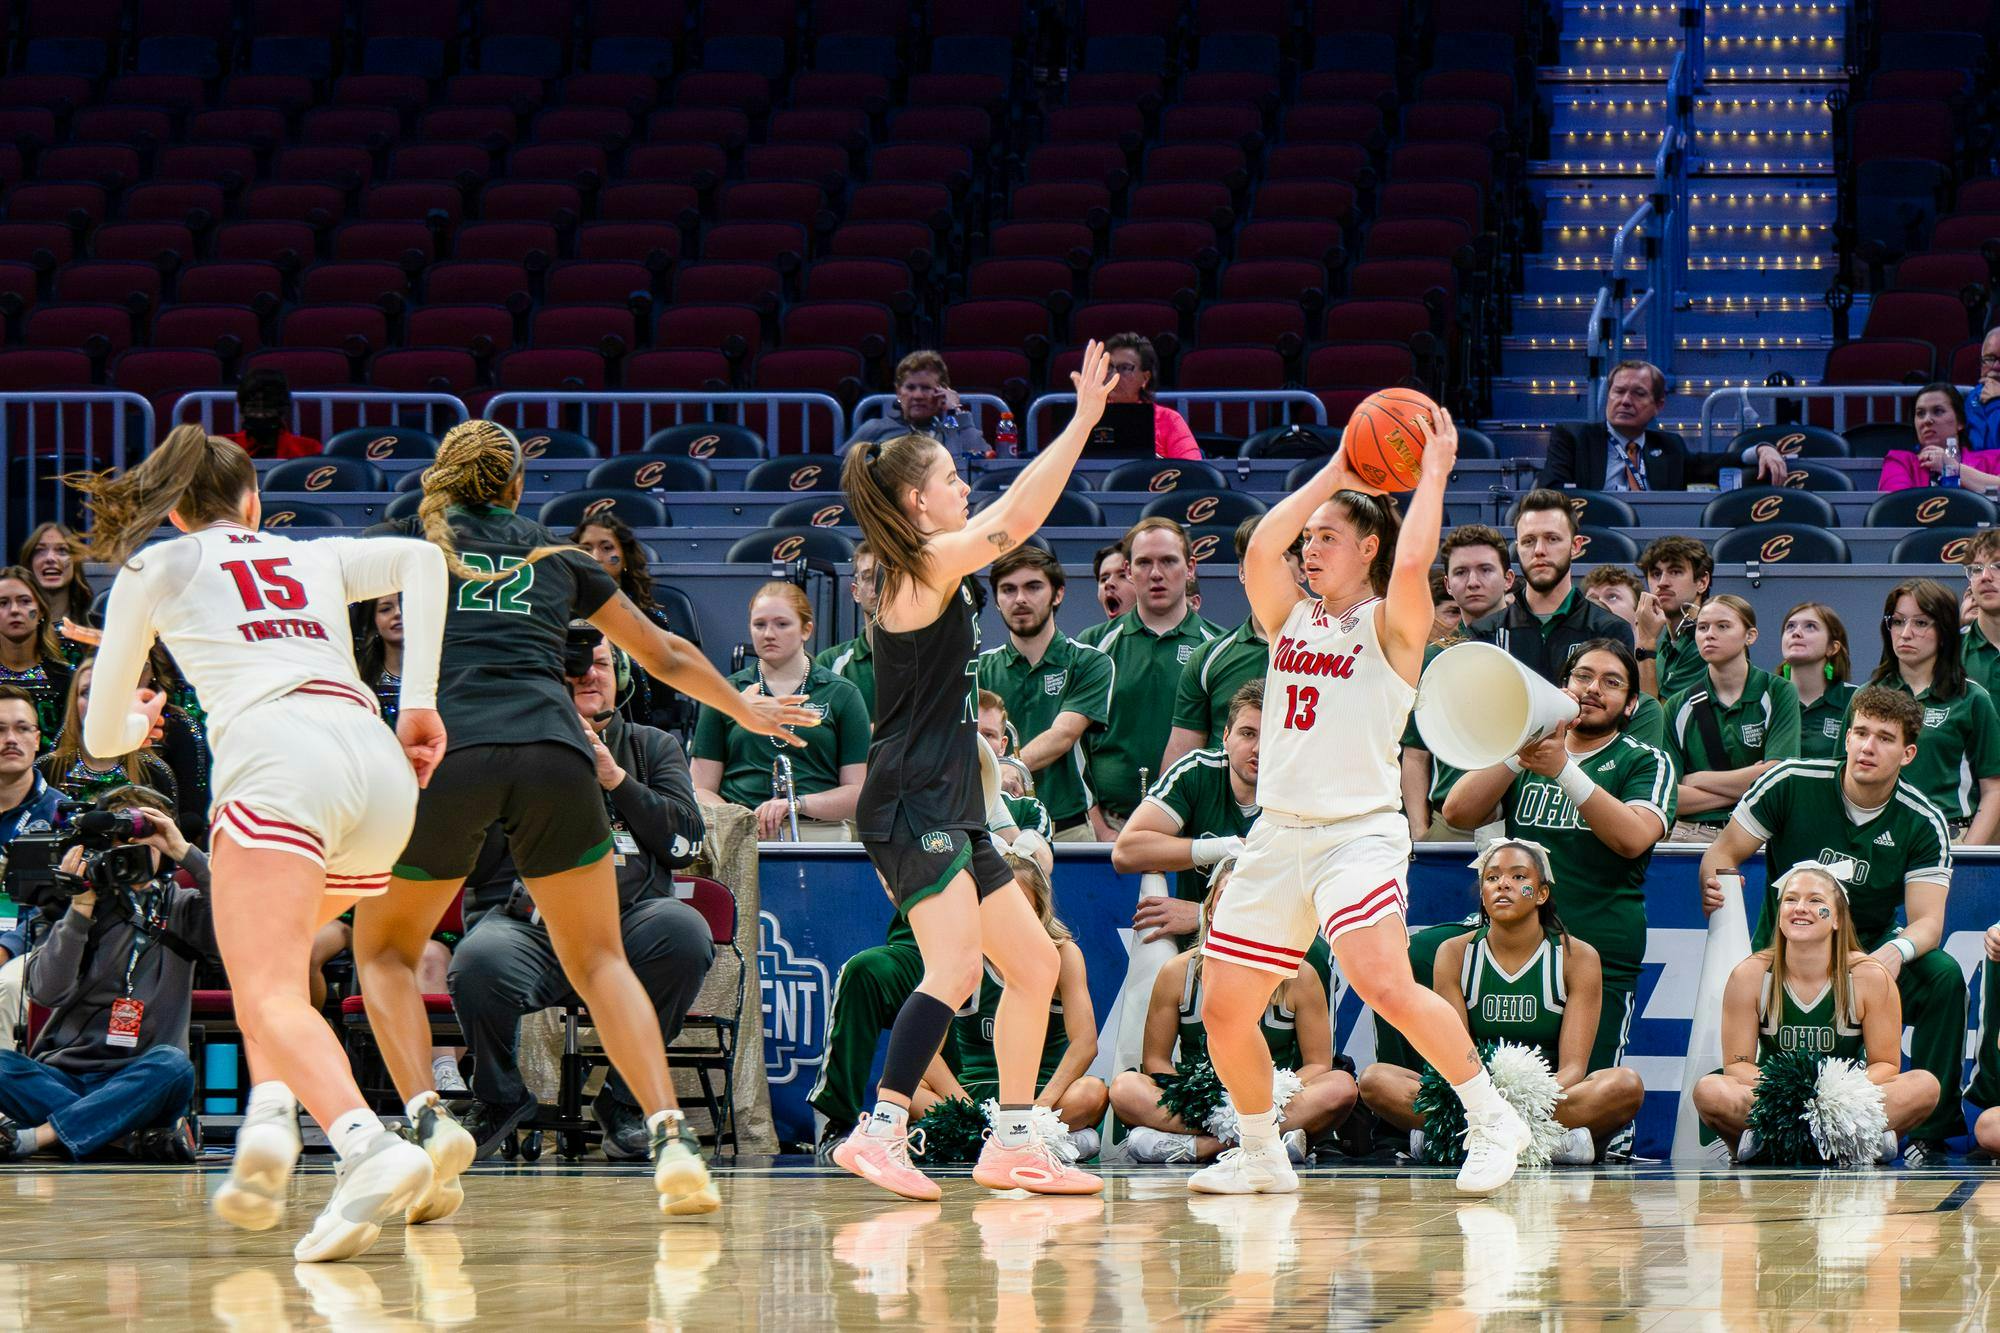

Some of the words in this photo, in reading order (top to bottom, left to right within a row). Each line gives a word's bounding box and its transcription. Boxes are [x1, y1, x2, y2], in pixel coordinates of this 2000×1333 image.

[366, 436, 398, 460] C
[520, 436, 551, 459] C
[688, 435, 720, 459] C
[305, 465, 337, 492] C
[635, 461, 667, 488] C
[789, 465, 822, 491] C
[1149, 469, 1182, 493] C
[811, 504, 845, 527] C
[1186, 496, 1219, 524] C
[1751, 495, 1783, 523] C
[1916, 496, 1949, 524] C
[772, 535, 806, 563] C
[1760, 534, 1793, 563] C
[220, 557, 308, 612] 15
[457, 552, 534, 616] 22
[1273, 635, 1363, 680] Miami
[1283, 684, 1320, 731] 13
[1515, 782, 1592, 831] OHI
[1817, 847, 1871, 886] OO
[1482, 994, 1537, 1022] OHIO
[1779, 1025, 1835, 1052] OHIO
